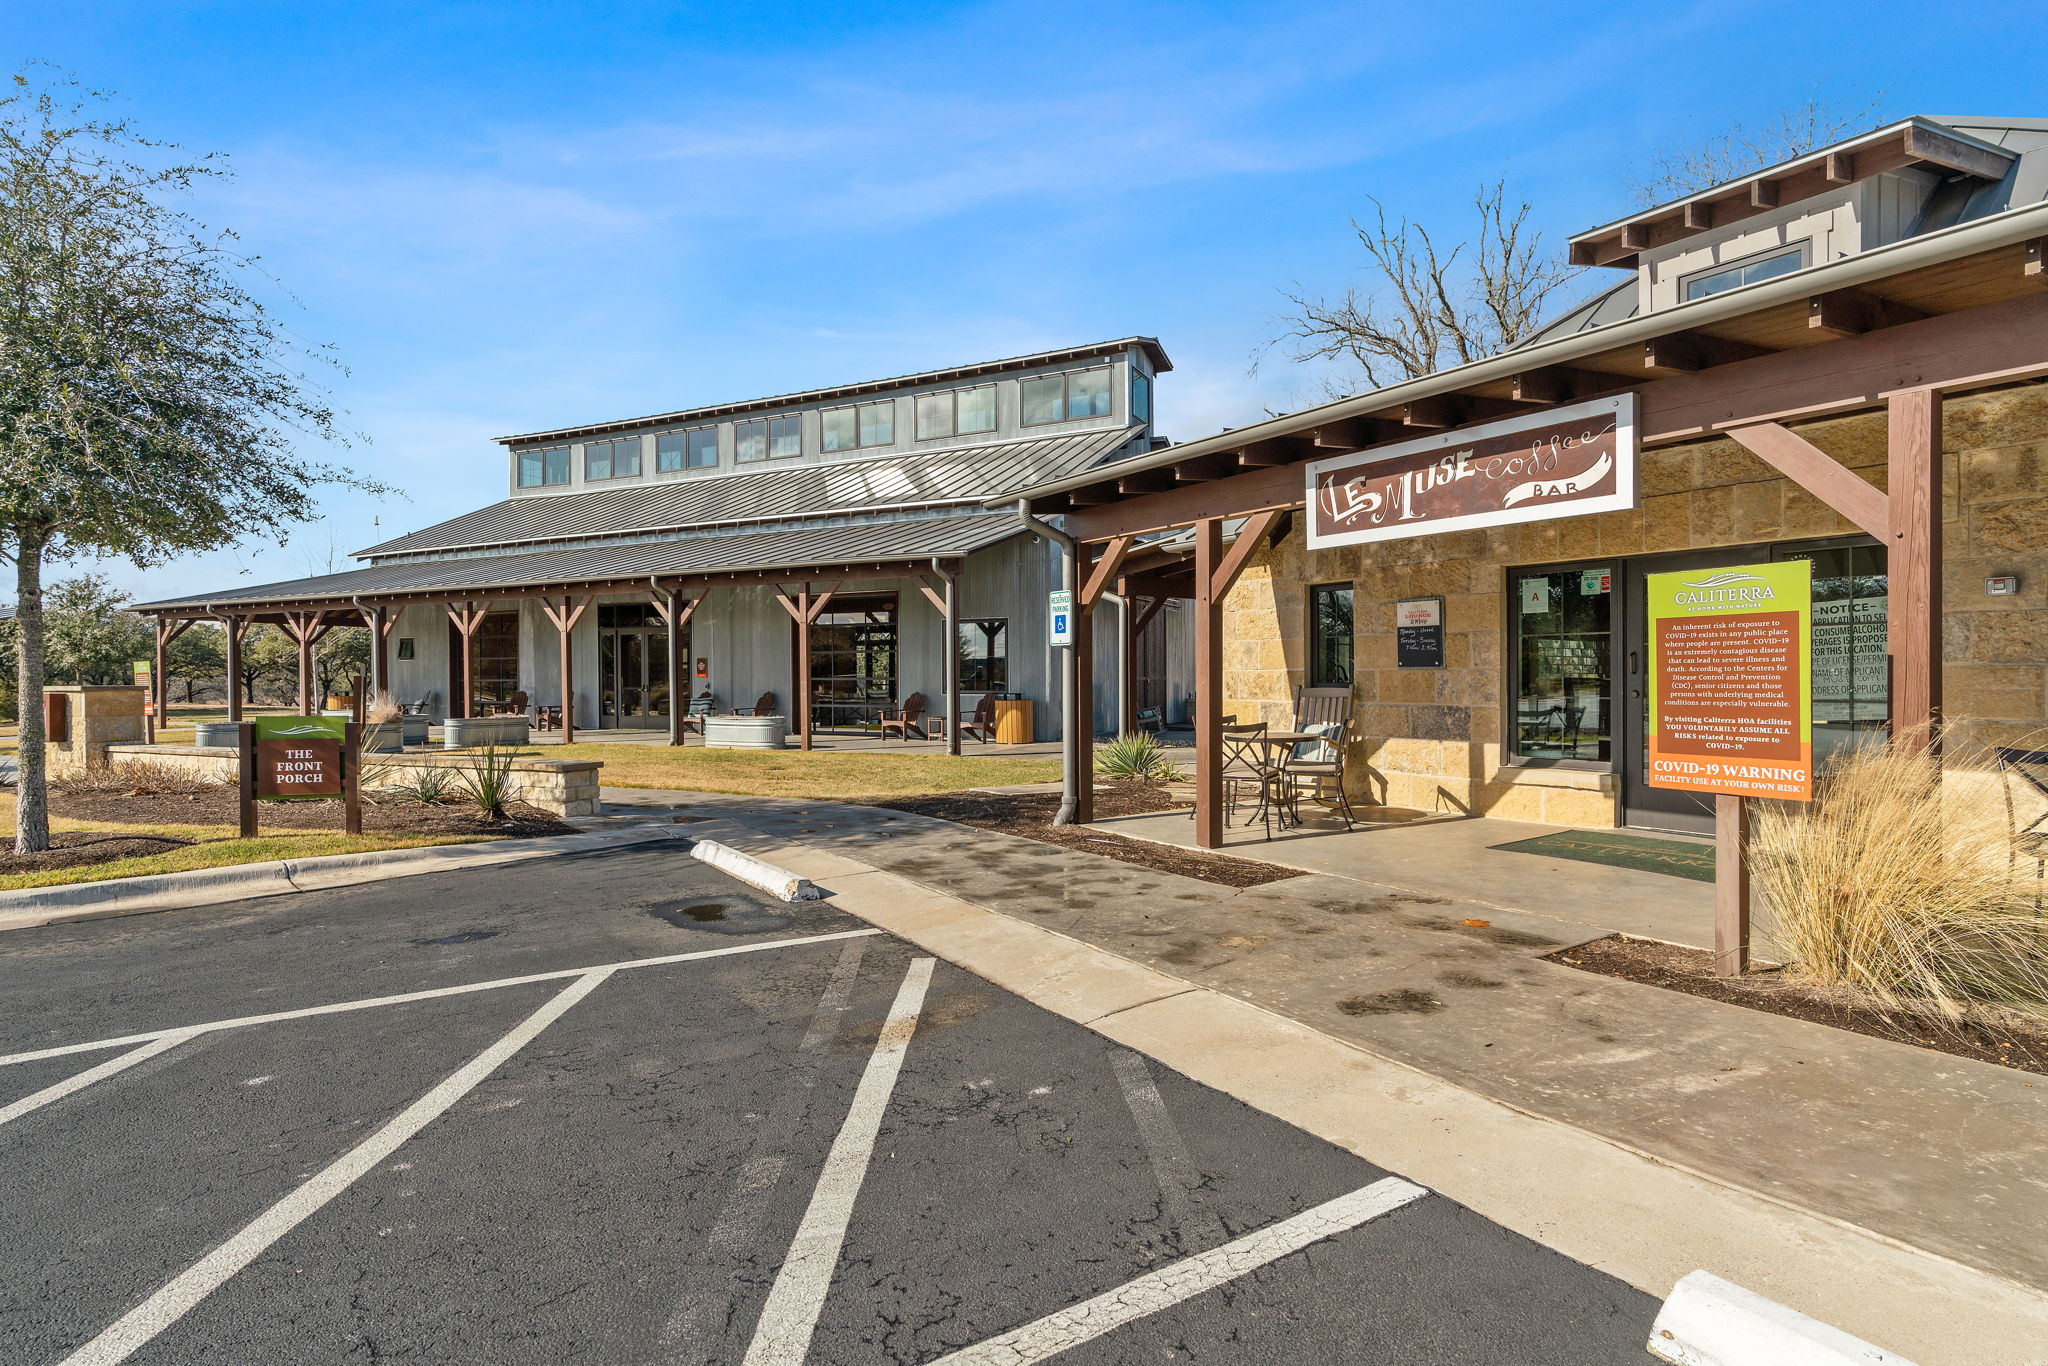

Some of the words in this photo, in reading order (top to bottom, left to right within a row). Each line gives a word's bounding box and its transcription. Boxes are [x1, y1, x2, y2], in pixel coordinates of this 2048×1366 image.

[1371, 448, 1476, 523] MUSE
[1533, 482, 1580, 498] BAR
[1051, 596, 1070, 604] RESERVED
[1532, 593, 1539, 601] A
[1675, 586, 1775, 605] CALITERRA
[1813, 615, 1860, 625] APPLICATIN
[1862, 614, 1872, 623] TO
[1737, 621, 1770, 629] exposure
[1744, 629, 1767, 637] public
[1686, 640, 1708, 648] people
[1722, 639, 1751, 647] present.
[1684, 648, 1717, 656] extremely
[1719, 647, 1758, 656] contagious
[1759, 646, 1787, 654] disease
[1826, 646, 1843, 655] THIS
[1689, 665, 1723, 673] According
[1846, 666, 1887, 676] APLICANT:
[1671, 682, 1693, 690] (CDC),
[1714, 691, 1753, 699] underlying
[1712, 699, 1748, 708] especially
[1664, 715, 1673, 723] By
[1674, 716, 1702, 724] visiting
[1703, 716, 1736, 724] Caliterra
[1756, 718, 1792, 726] facilities
[1683, 724, 1737, 733] VOLUNTARILY
[1674, 732, 1697, 740] RISKS
[1735, 736, 1770, 744] exposure
[1705, 742, 1745, 751] COVID-19.
[285, 749, 313, 759] THE
[276, 761, 323, 772] FRONT
[1654, 760, 1720, 776] COVID-19
[1721, 764, 1806, 782] WARNING
[276, 773, 324, 784] PORCH
[1654, 774, 1691, 784] FACILITY
[1692, 777, 1710, 786] USE
[1710, 778, 1722, 787] AT
[1723, 780, 1749, 789] YOUR
[1751, 781, 1775, 791] OWN
